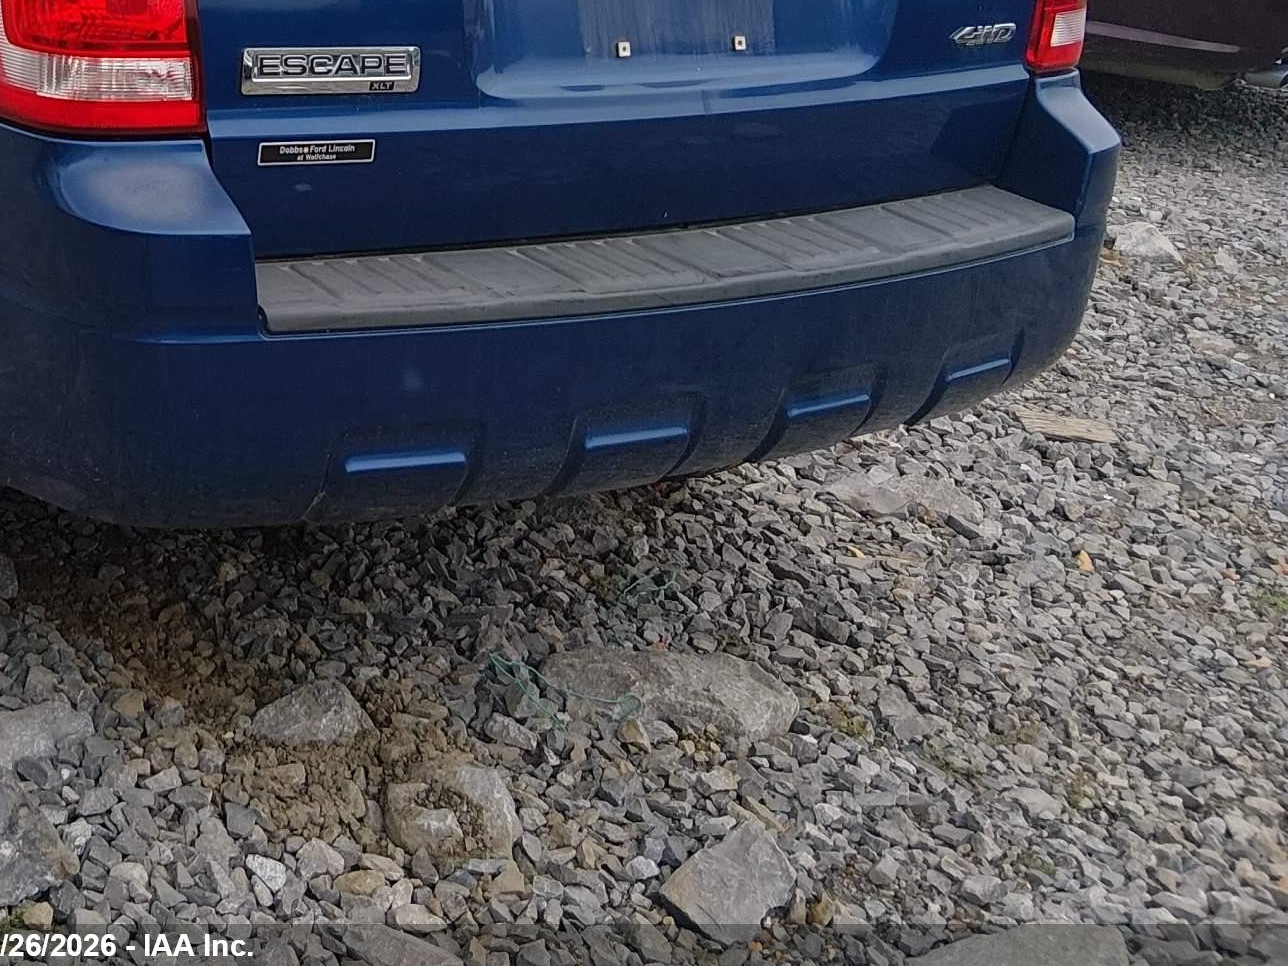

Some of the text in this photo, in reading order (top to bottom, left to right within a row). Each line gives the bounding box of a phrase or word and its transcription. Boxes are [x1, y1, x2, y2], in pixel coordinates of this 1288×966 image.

[949, 22, 1017, 46] 4WD
[258, 54, 408, 76] ESCAPE
[372, 82, 393, 90] XLT
[279, 143, 355, 154] Dobbs Ford Lincoln
